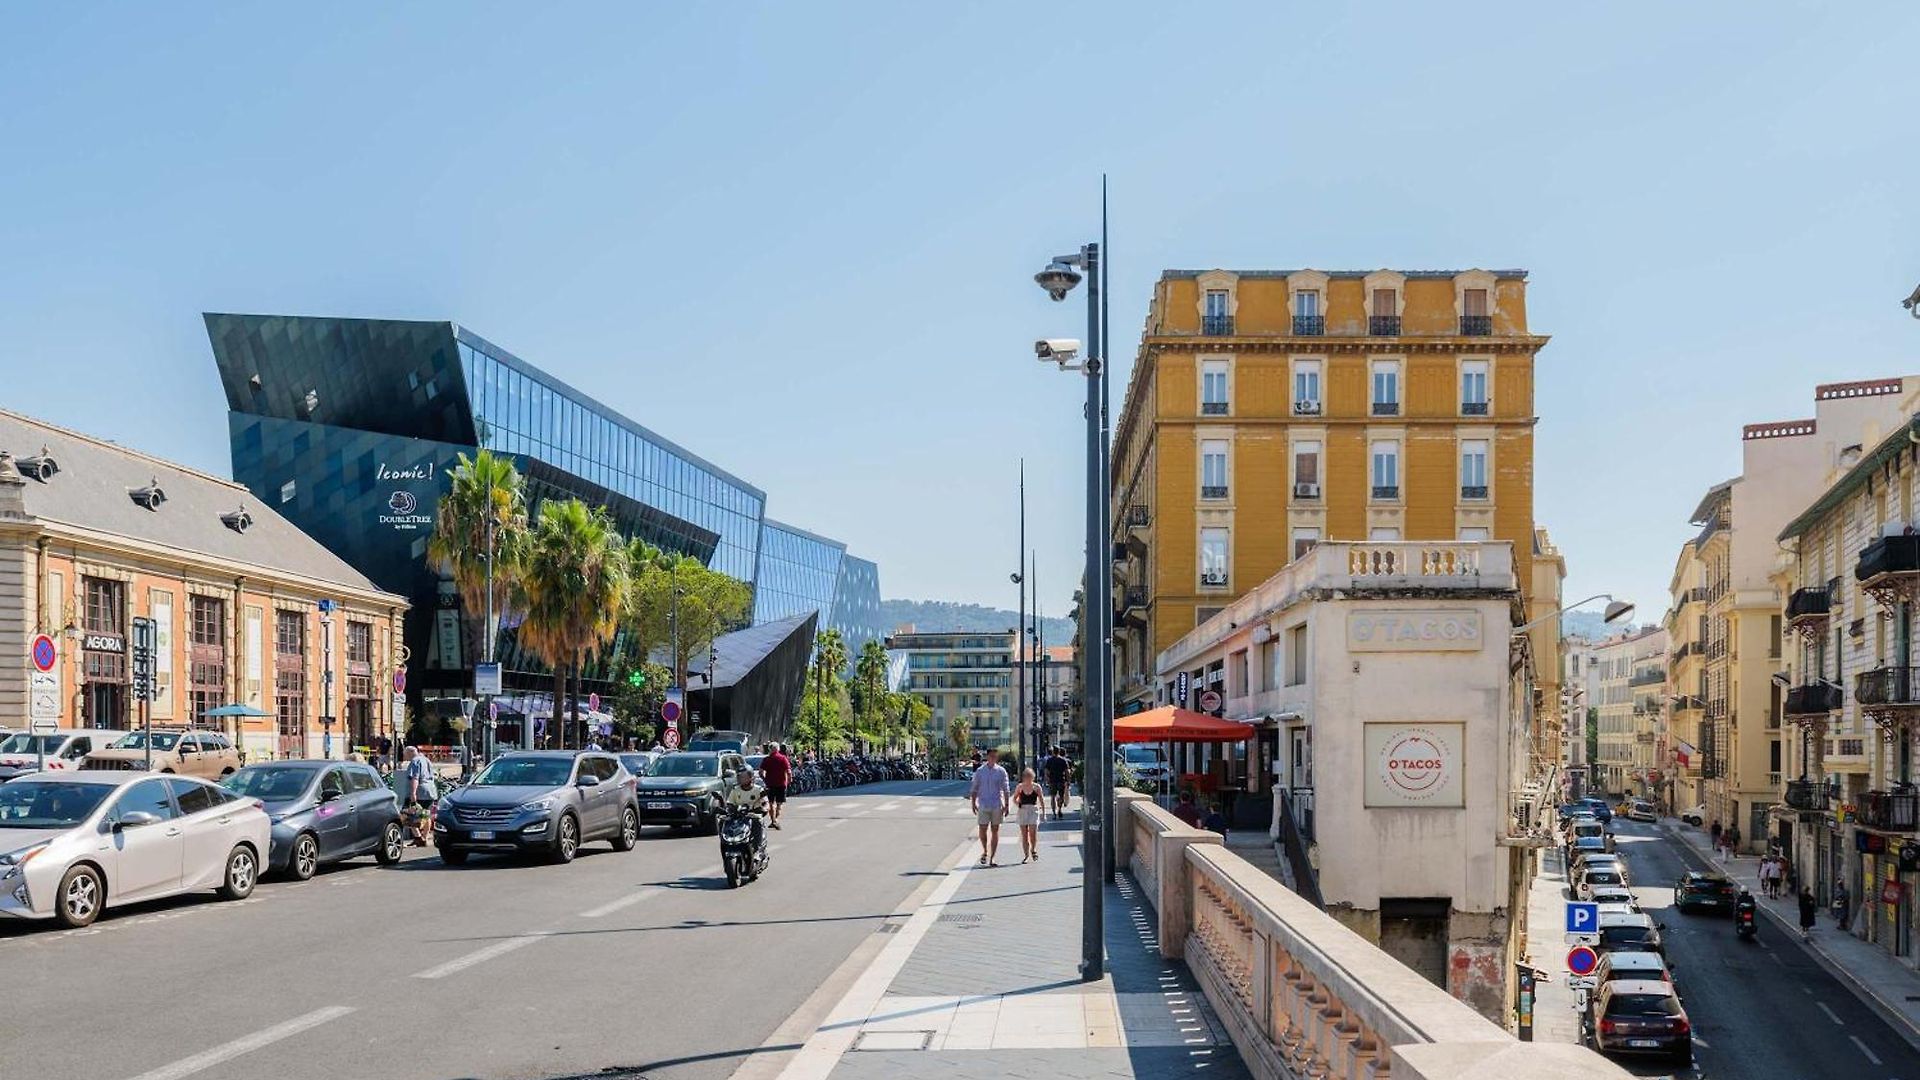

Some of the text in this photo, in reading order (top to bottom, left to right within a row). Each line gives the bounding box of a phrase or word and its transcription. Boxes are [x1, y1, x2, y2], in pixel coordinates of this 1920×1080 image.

[376, 462, 434, 480] Iconic!
[1352, 618, 1479, 641] O'TACOS
[86, 637, 121, 650] AGORA
[1389, 760, 1441, 769] O'TACOS
[1574, 908, 1589, 928] P
